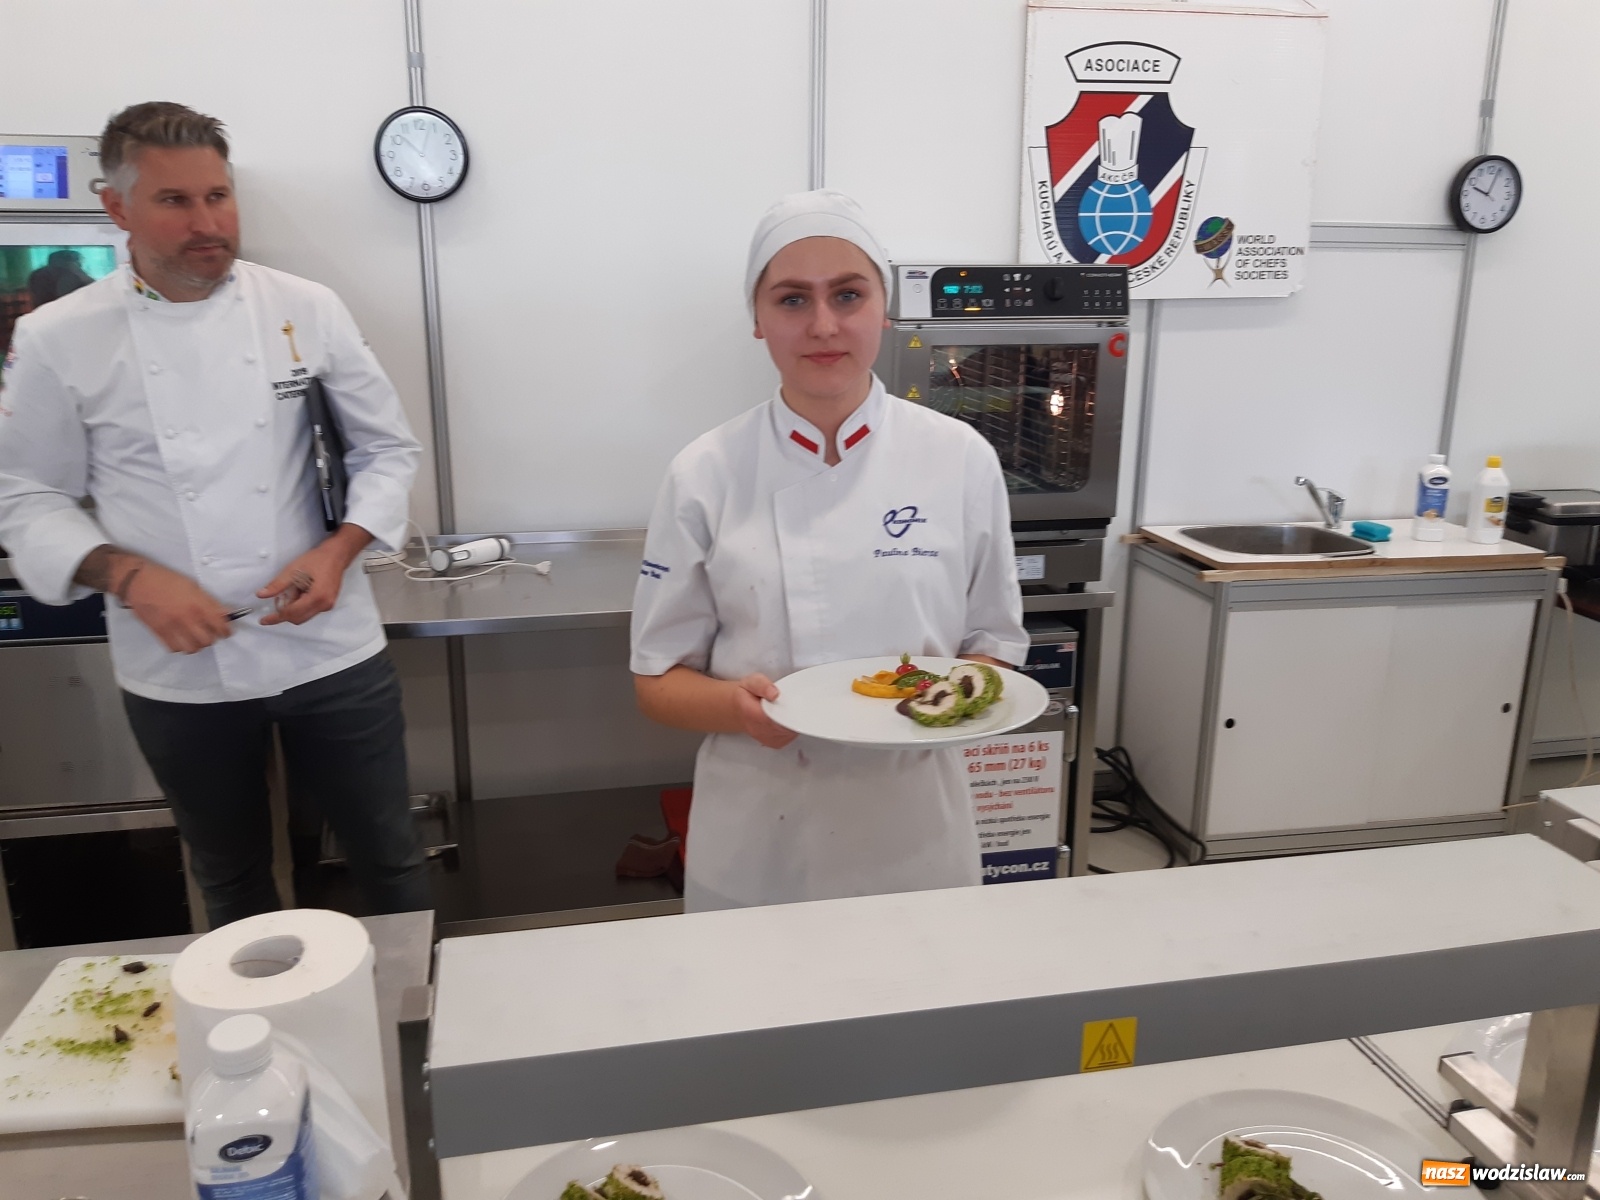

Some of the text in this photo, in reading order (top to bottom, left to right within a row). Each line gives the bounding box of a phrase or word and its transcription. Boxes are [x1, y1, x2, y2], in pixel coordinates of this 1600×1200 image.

[1084, 58, 1161, 72] ASOCIACE
[1164, 180, 1196, 258] REPUBLIKY
[1236, 234, 1277, 245] WORLD
[1235, 246, 1305, 257] ASSOCIATION
[1235, 258, 1288, 269] OF CHEFS
[1234, 270, 1290, 280] SOCIETIES
[1011, 744, 1026, 754] na
[1028, 741, 1035, 752] 6
[1037, 740, 1050, 752] ks
[967, 755, 1047, 773] 65 mm (27 kg)
